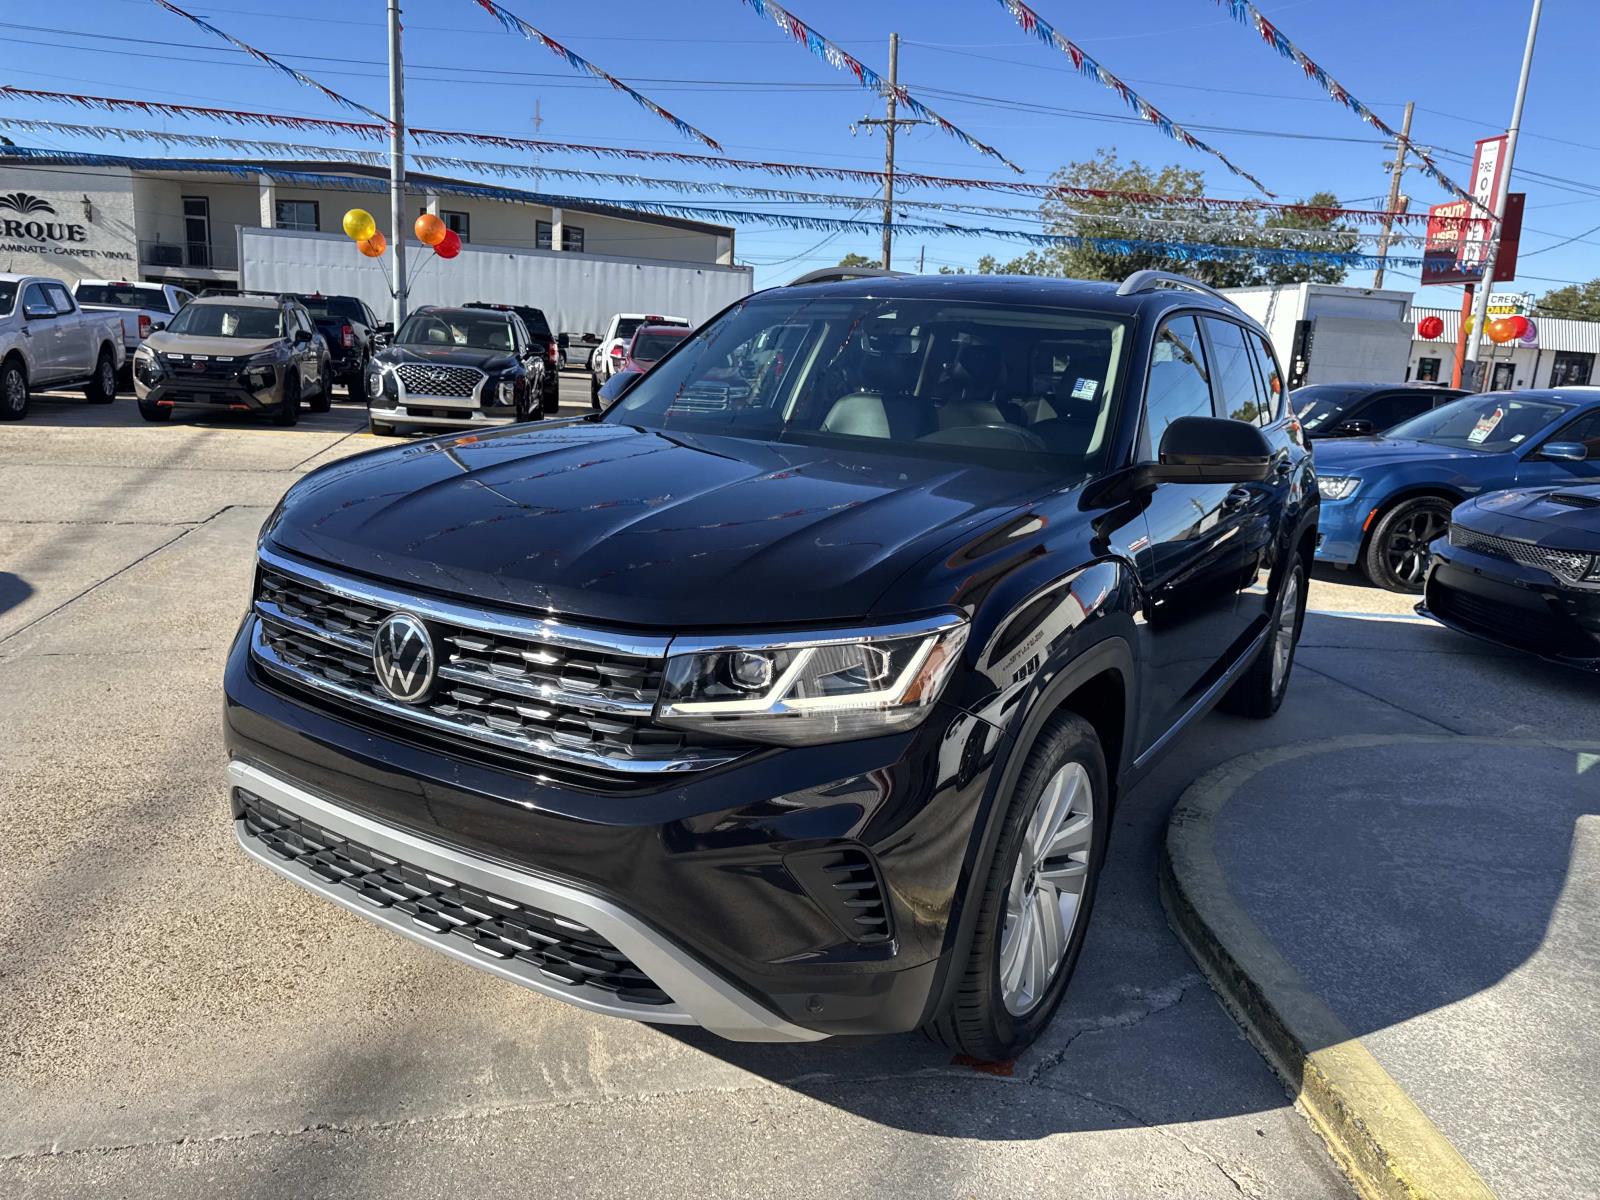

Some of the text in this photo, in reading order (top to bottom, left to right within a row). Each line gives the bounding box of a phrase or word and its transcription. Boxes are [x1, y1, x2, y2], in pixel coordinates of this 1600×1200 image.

[0, 219, 88, 243] RQUE
[54, 247, 97, 257] CARPET
[102, 250, 133, 260] VINYL
[1486, 305, 1517, 314] OANS
[377, 618, 429, 694] VW
